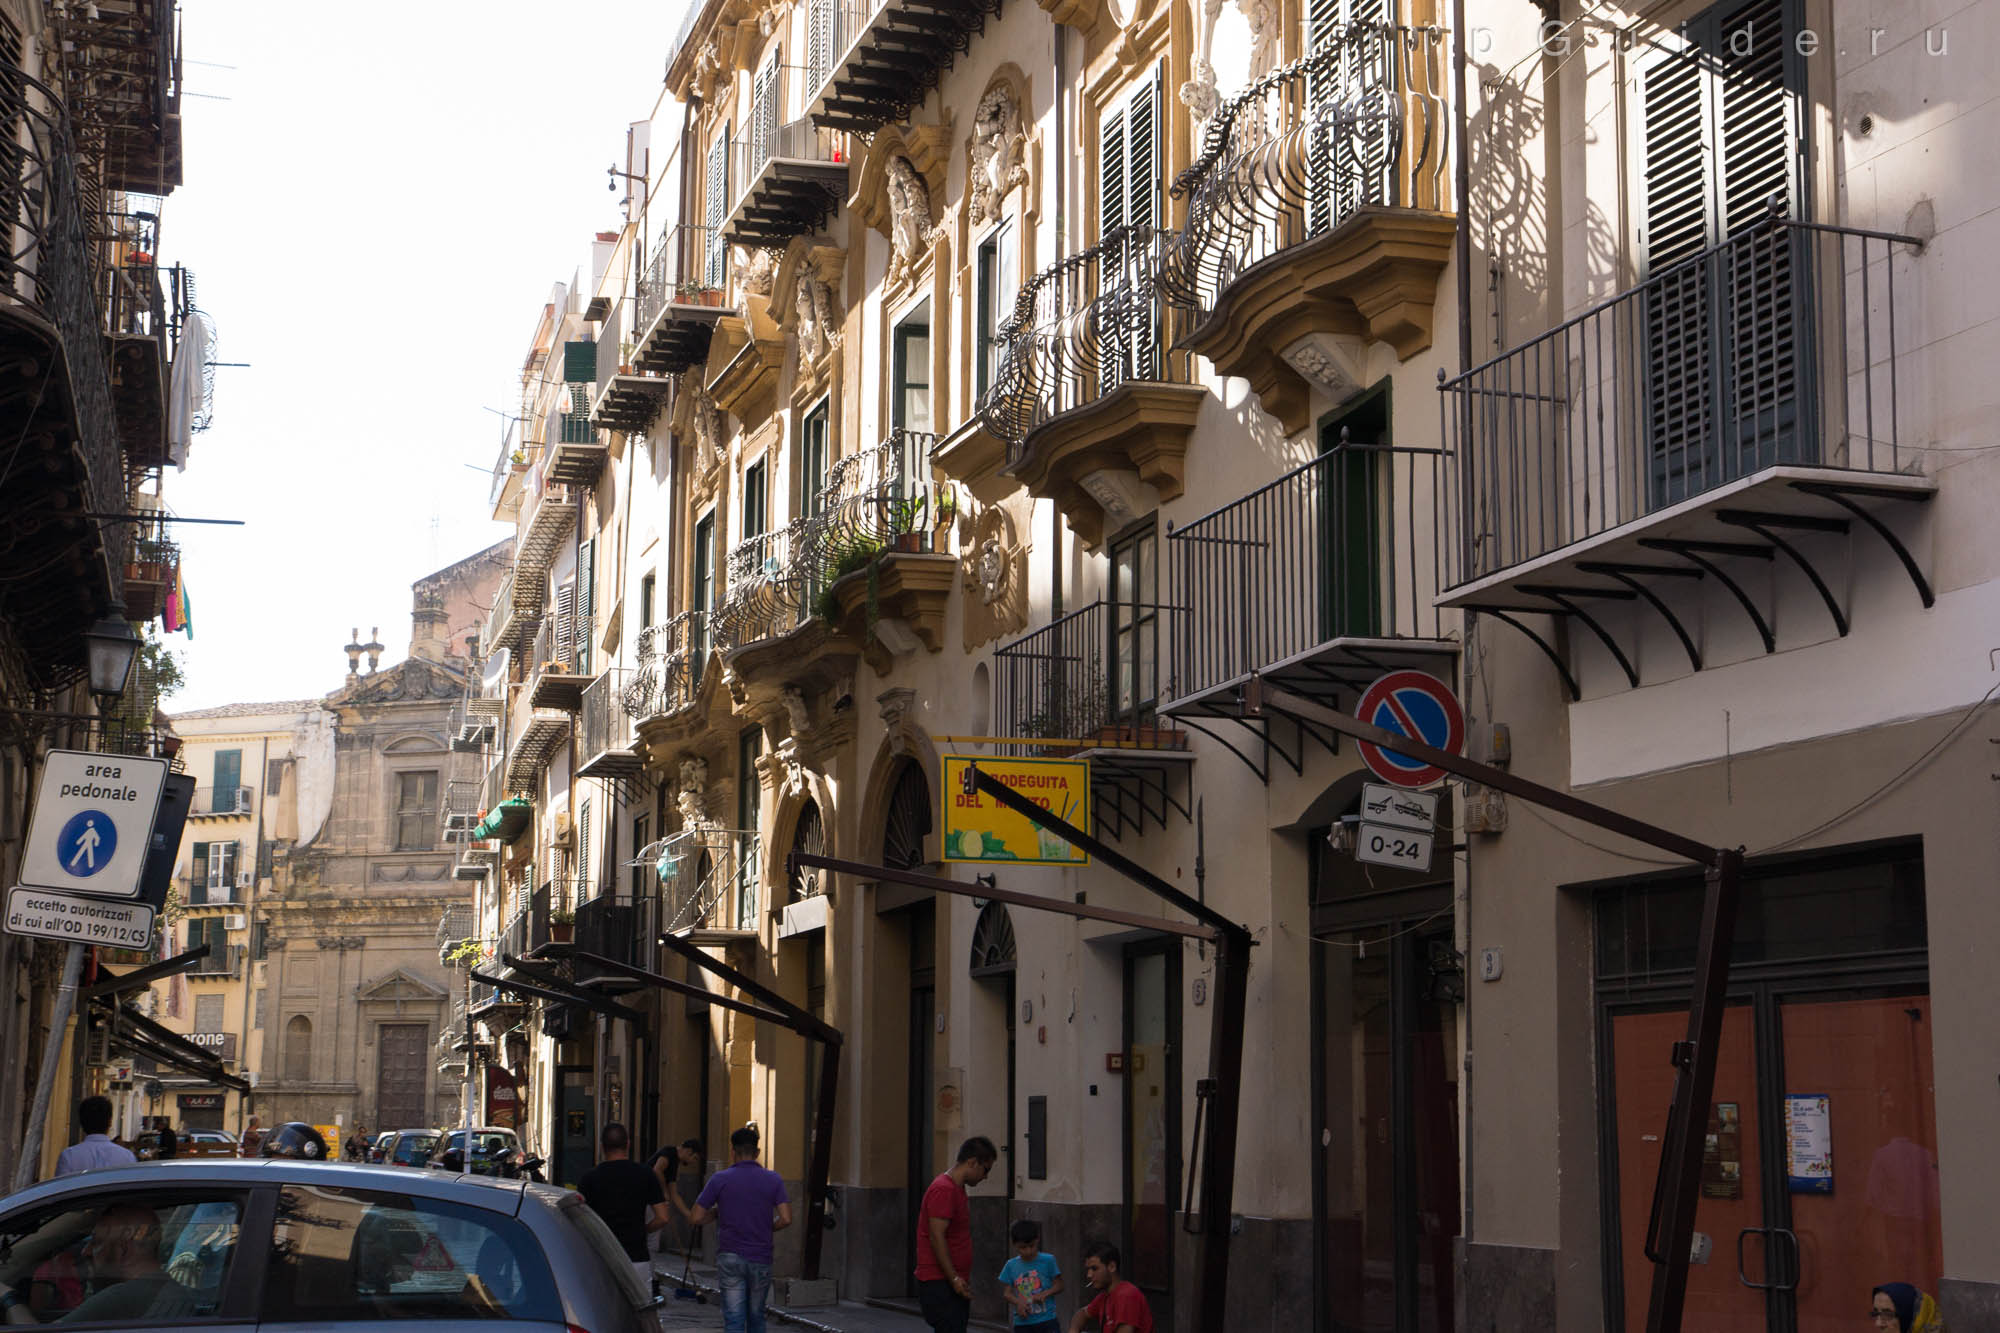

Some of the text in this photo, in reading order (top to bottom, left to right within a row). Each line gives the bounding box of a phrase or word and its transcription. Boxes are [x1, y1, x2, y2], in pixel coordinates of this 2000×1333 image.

[85, 765, 121, 779] area
[60, 783, 137, 801] pedonale
[955, 794, 983, 808] DEL
[1371, 836, 1420, 860] 0-24
[26, 899, 132, 922] eccetto autorizzati
[10, 912, 22, 926] di
[25, 916, 42, 926] cui
[87, 923, 145, 943] 199/12/CS
